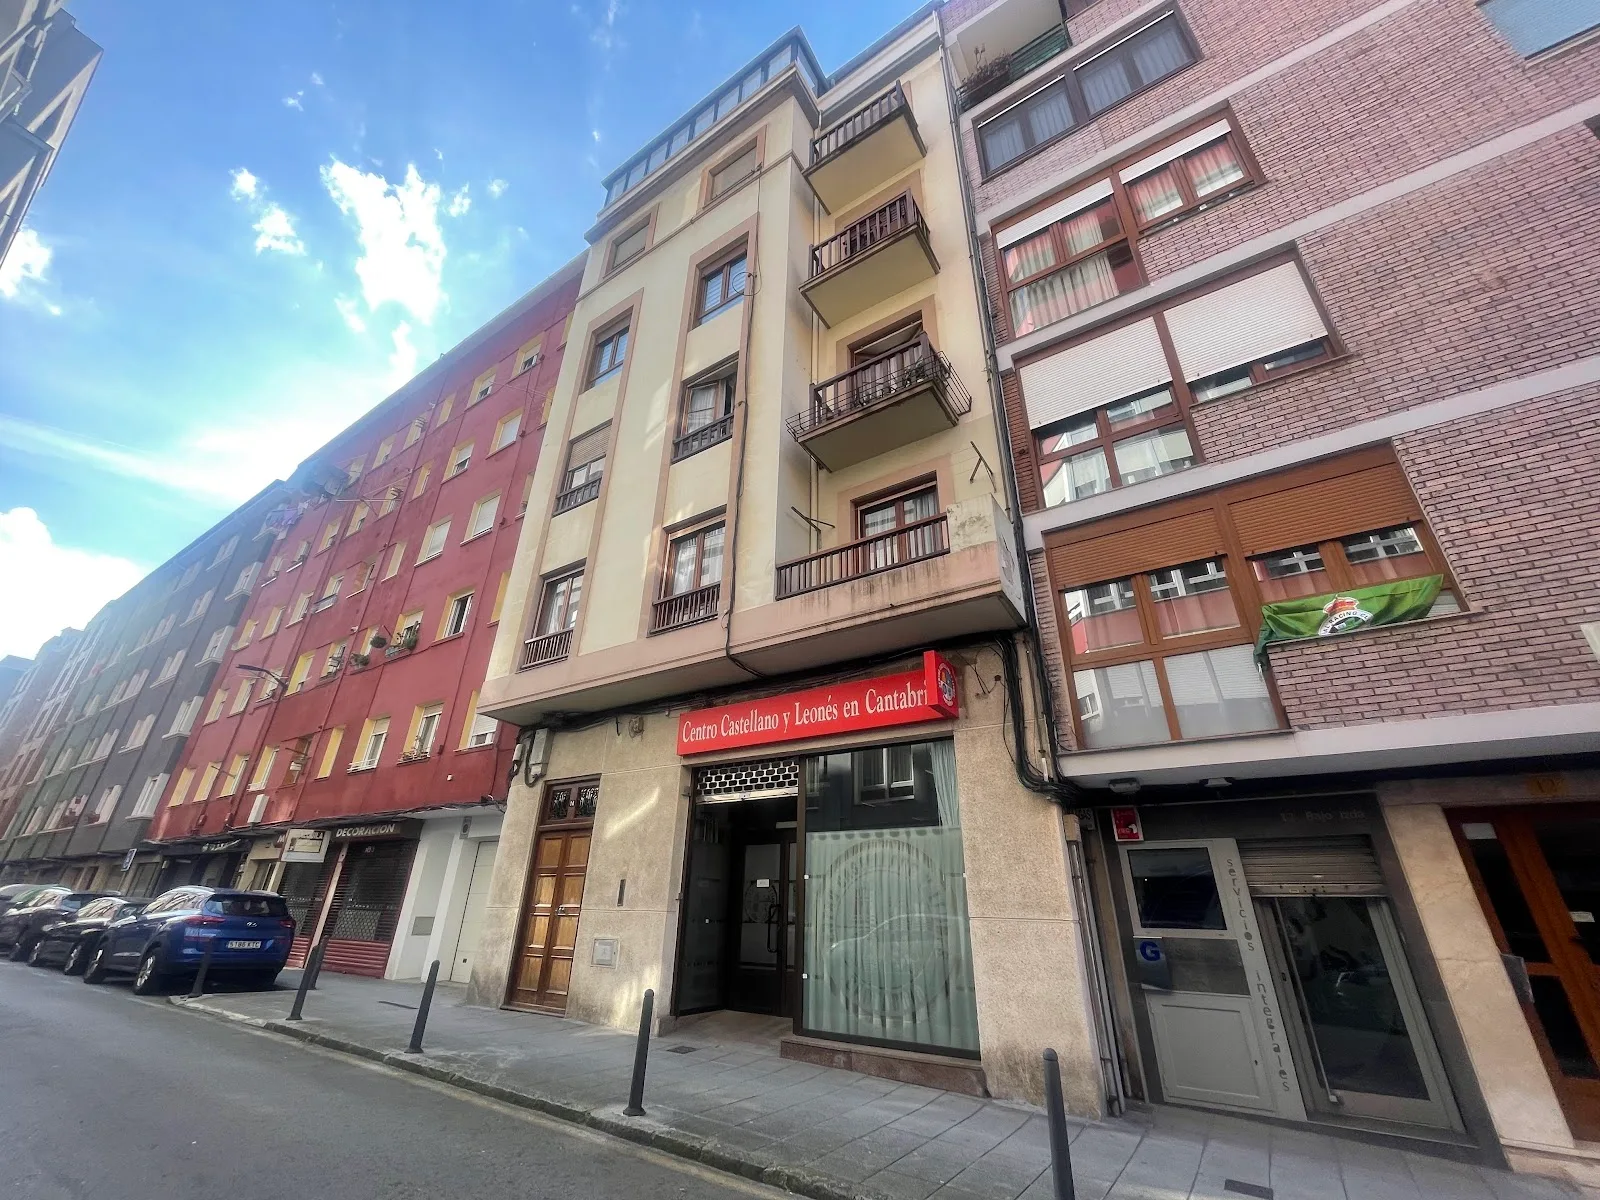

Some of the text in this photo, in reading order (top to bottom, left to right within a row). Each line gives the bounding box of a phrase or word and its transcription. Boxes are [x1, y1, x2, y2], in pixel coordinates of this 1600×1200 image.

[1329, 611, 1358, 624] RACING
[682, 721, 718, 742] Centro
[721, 709, 779, 737] Castellano
[783, 712, 790, 733] y
[795, 695, 838, 725] Leonés
[843, 699, 860, 718] en
[865, 680, 928, 714] Cantabri
[1139, 941, 1161, 962] G
